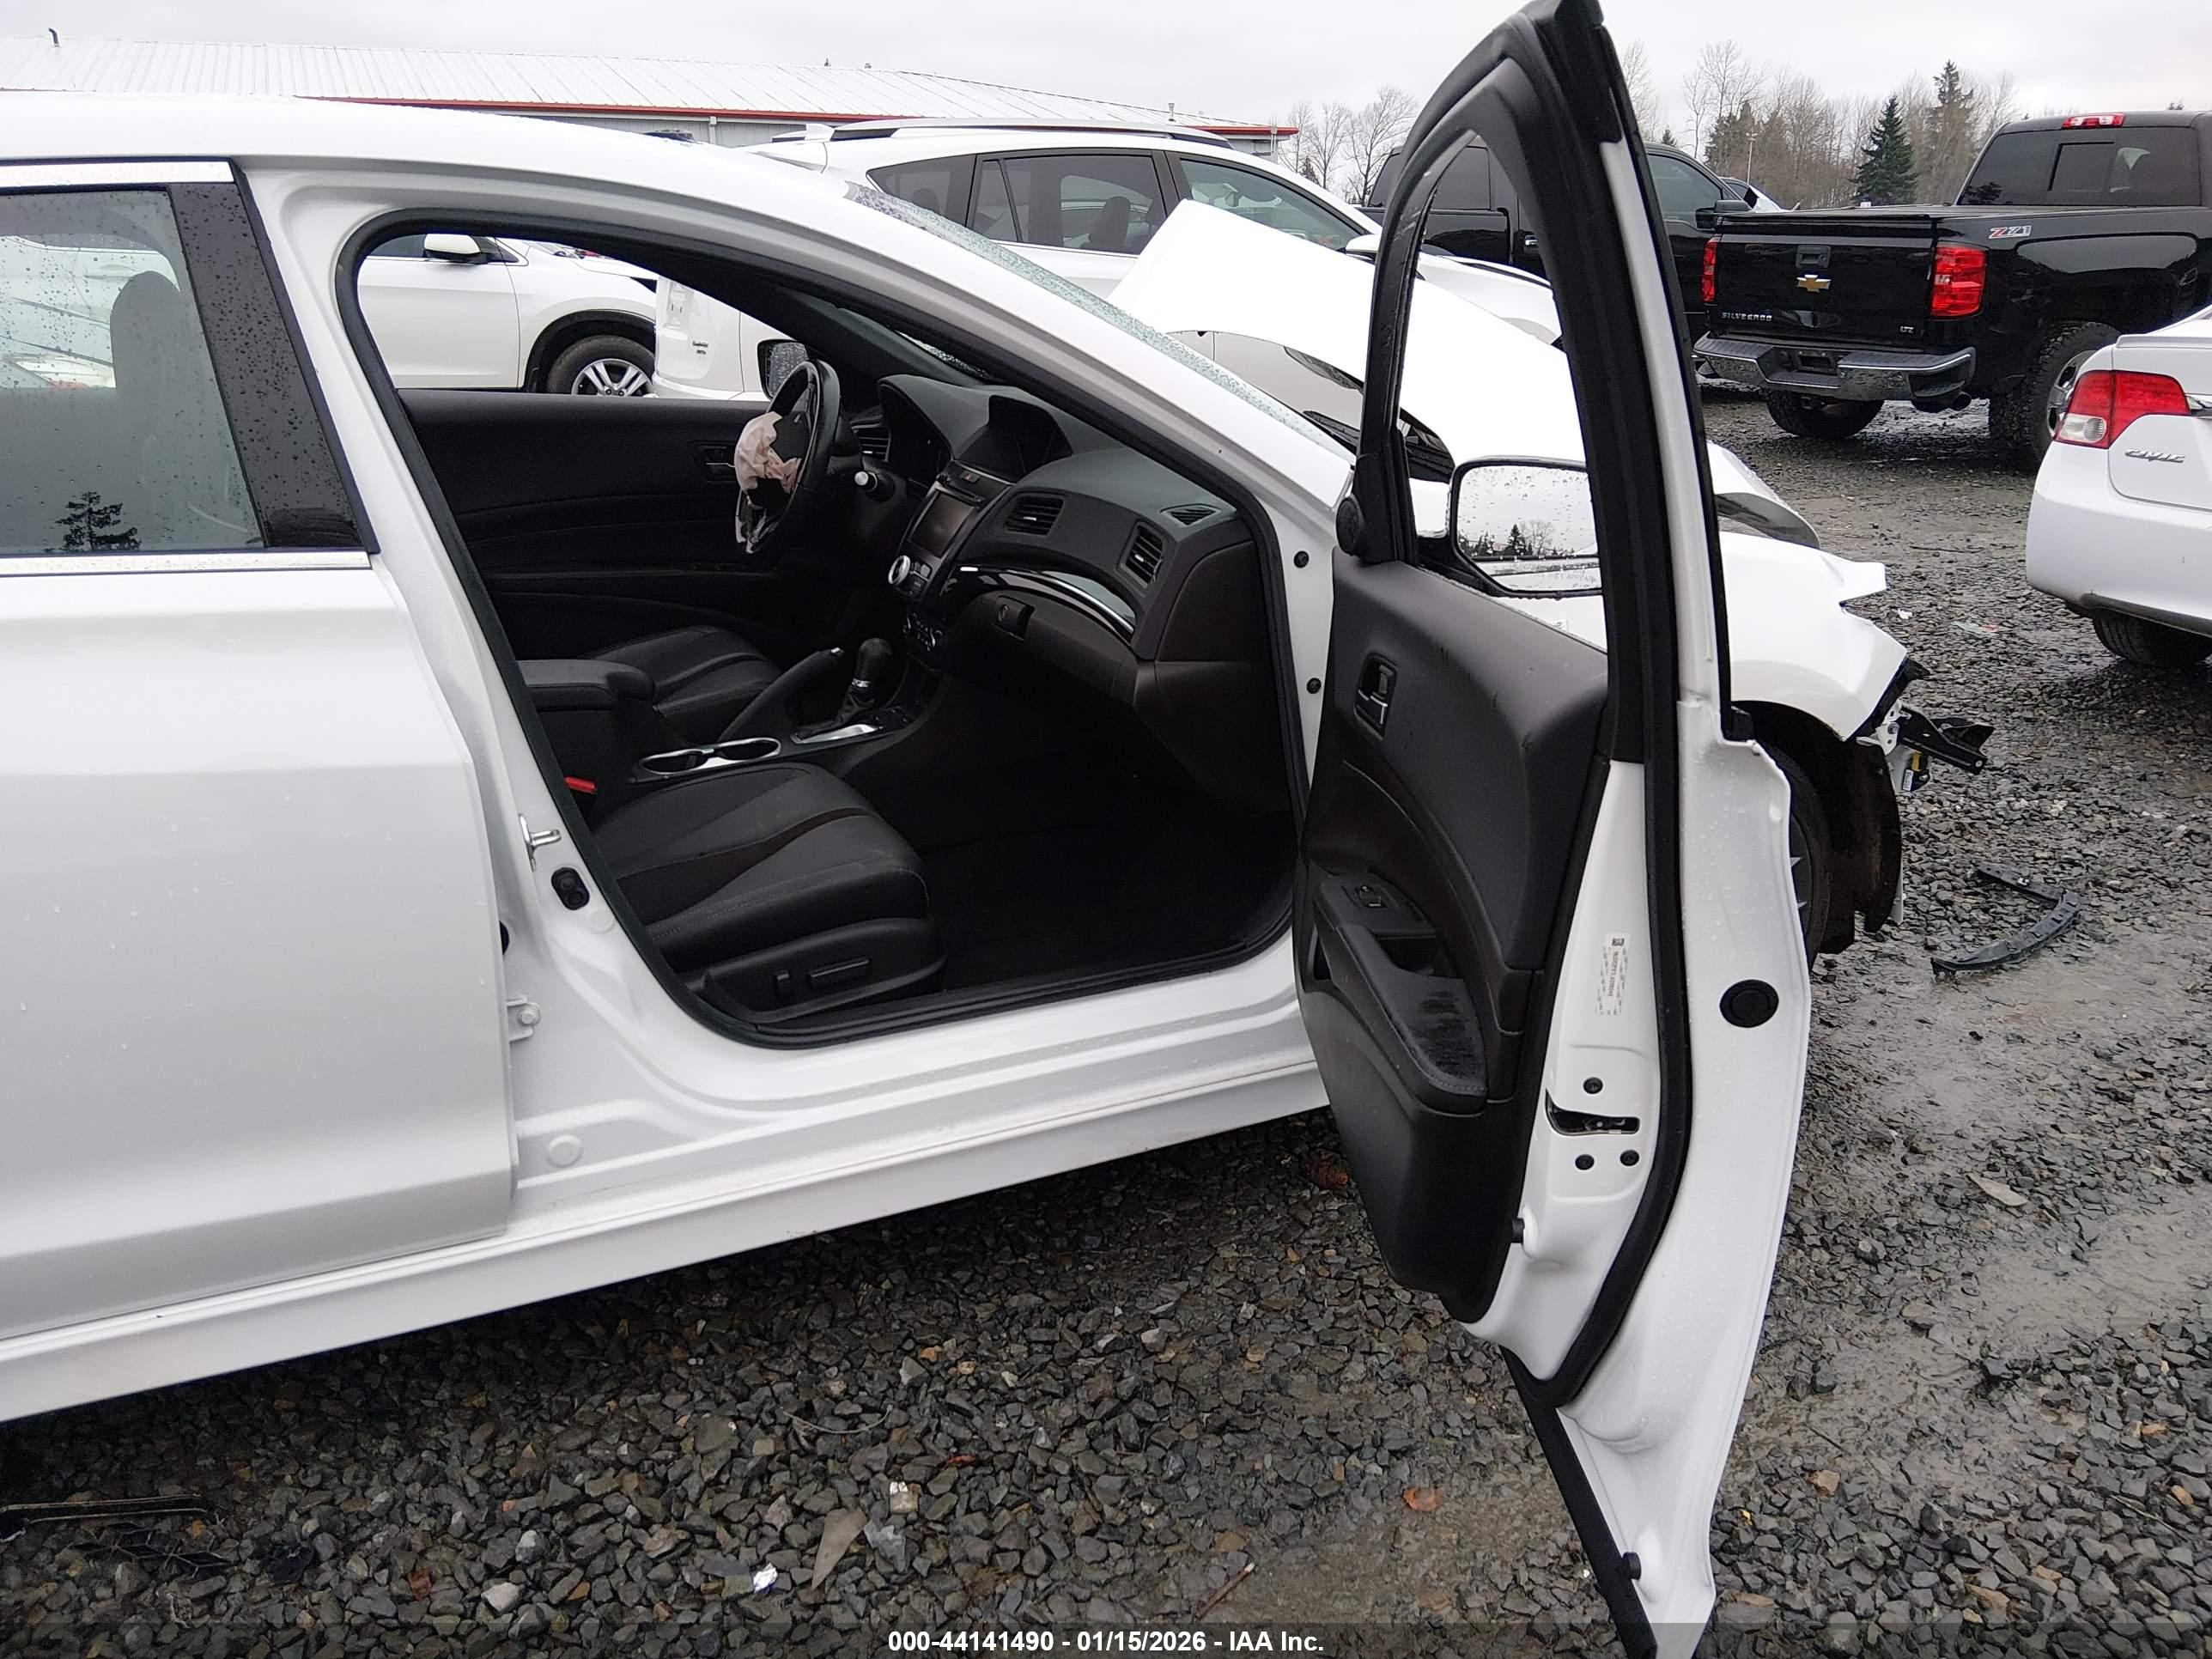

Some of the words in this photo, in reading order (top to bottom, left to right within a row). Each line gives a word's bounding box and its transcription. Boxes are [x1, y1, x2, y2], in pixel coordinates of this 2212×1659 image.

[1989, 225, 2033, 239] Z71
[1721, 312, 1772, 322] SILVERADO
[2124, 447, 2186, 463] CIVIC
